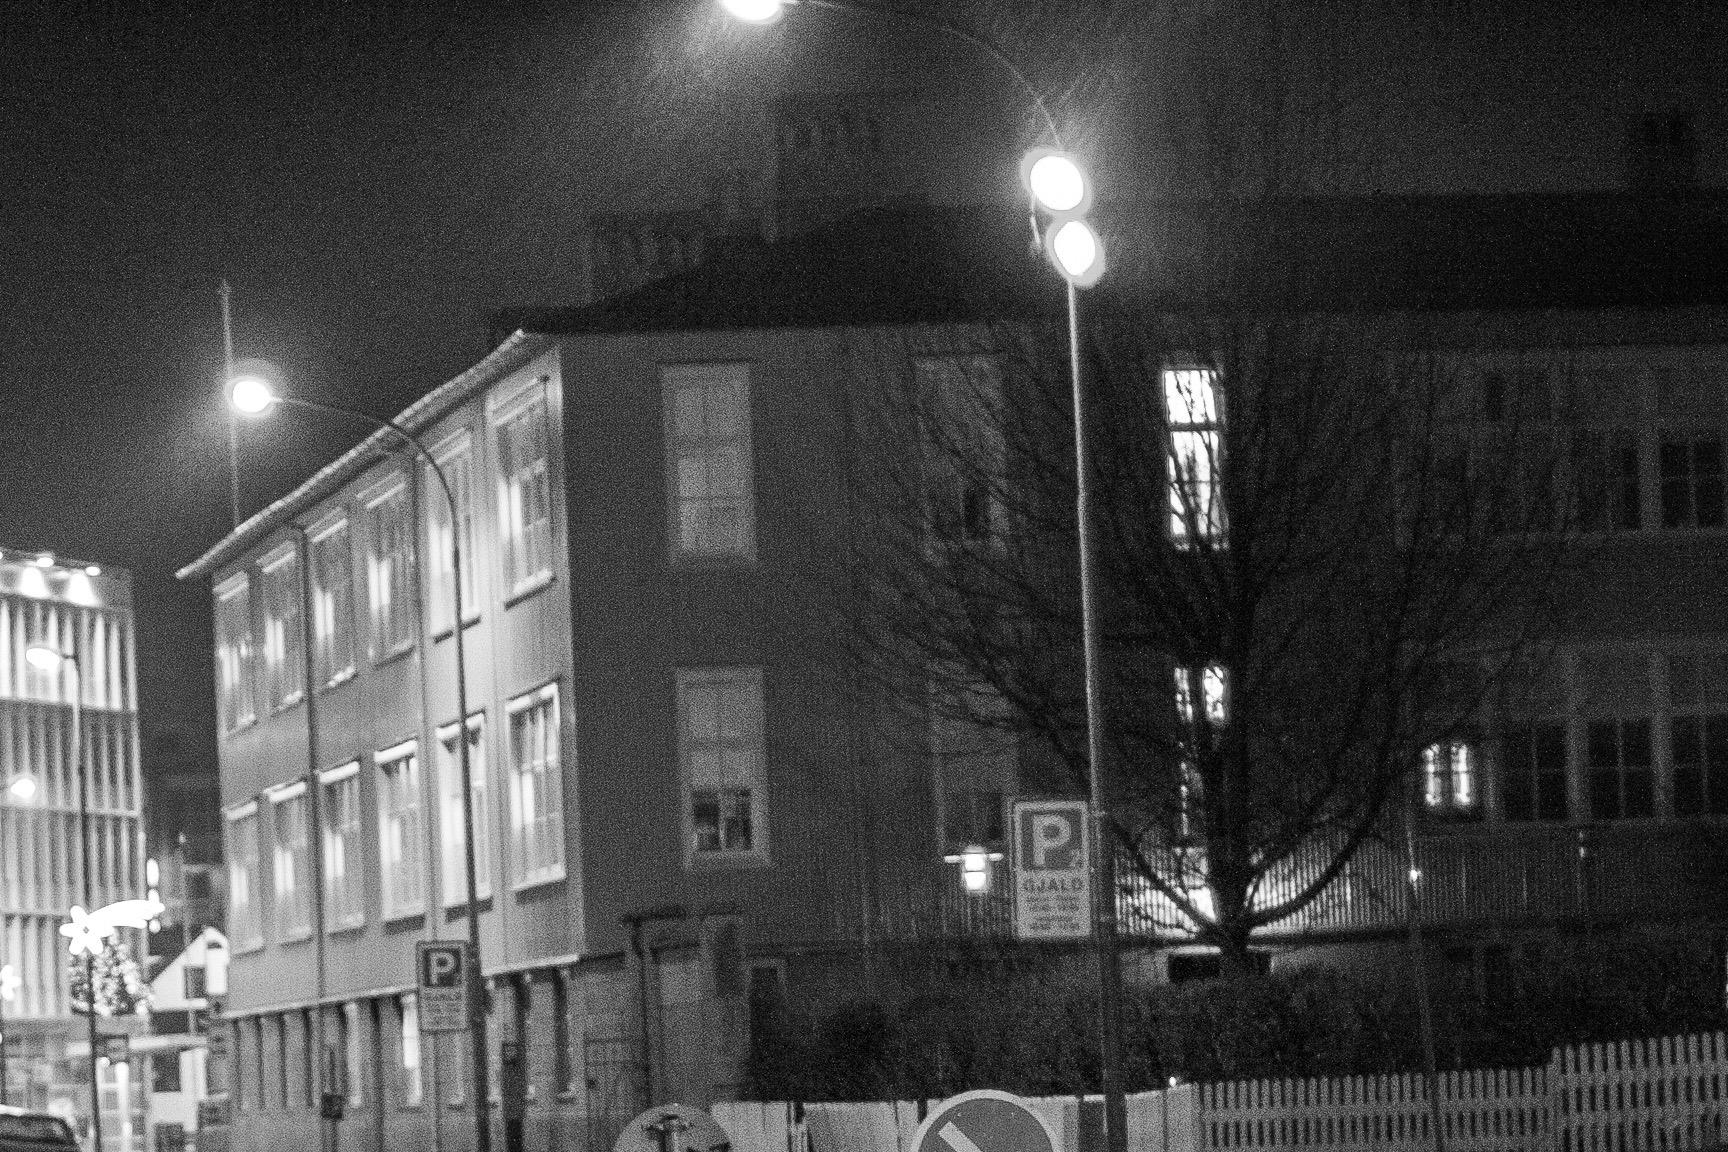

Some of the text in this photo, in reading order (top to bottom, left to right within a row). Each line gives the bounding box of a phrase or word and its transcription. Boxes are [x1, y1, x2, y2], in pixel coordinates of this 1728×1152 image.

[1033, 815, 1071, 866] P
[1023, 878, 1083, 893] GJALD
[430, 951, 456, 985] P
